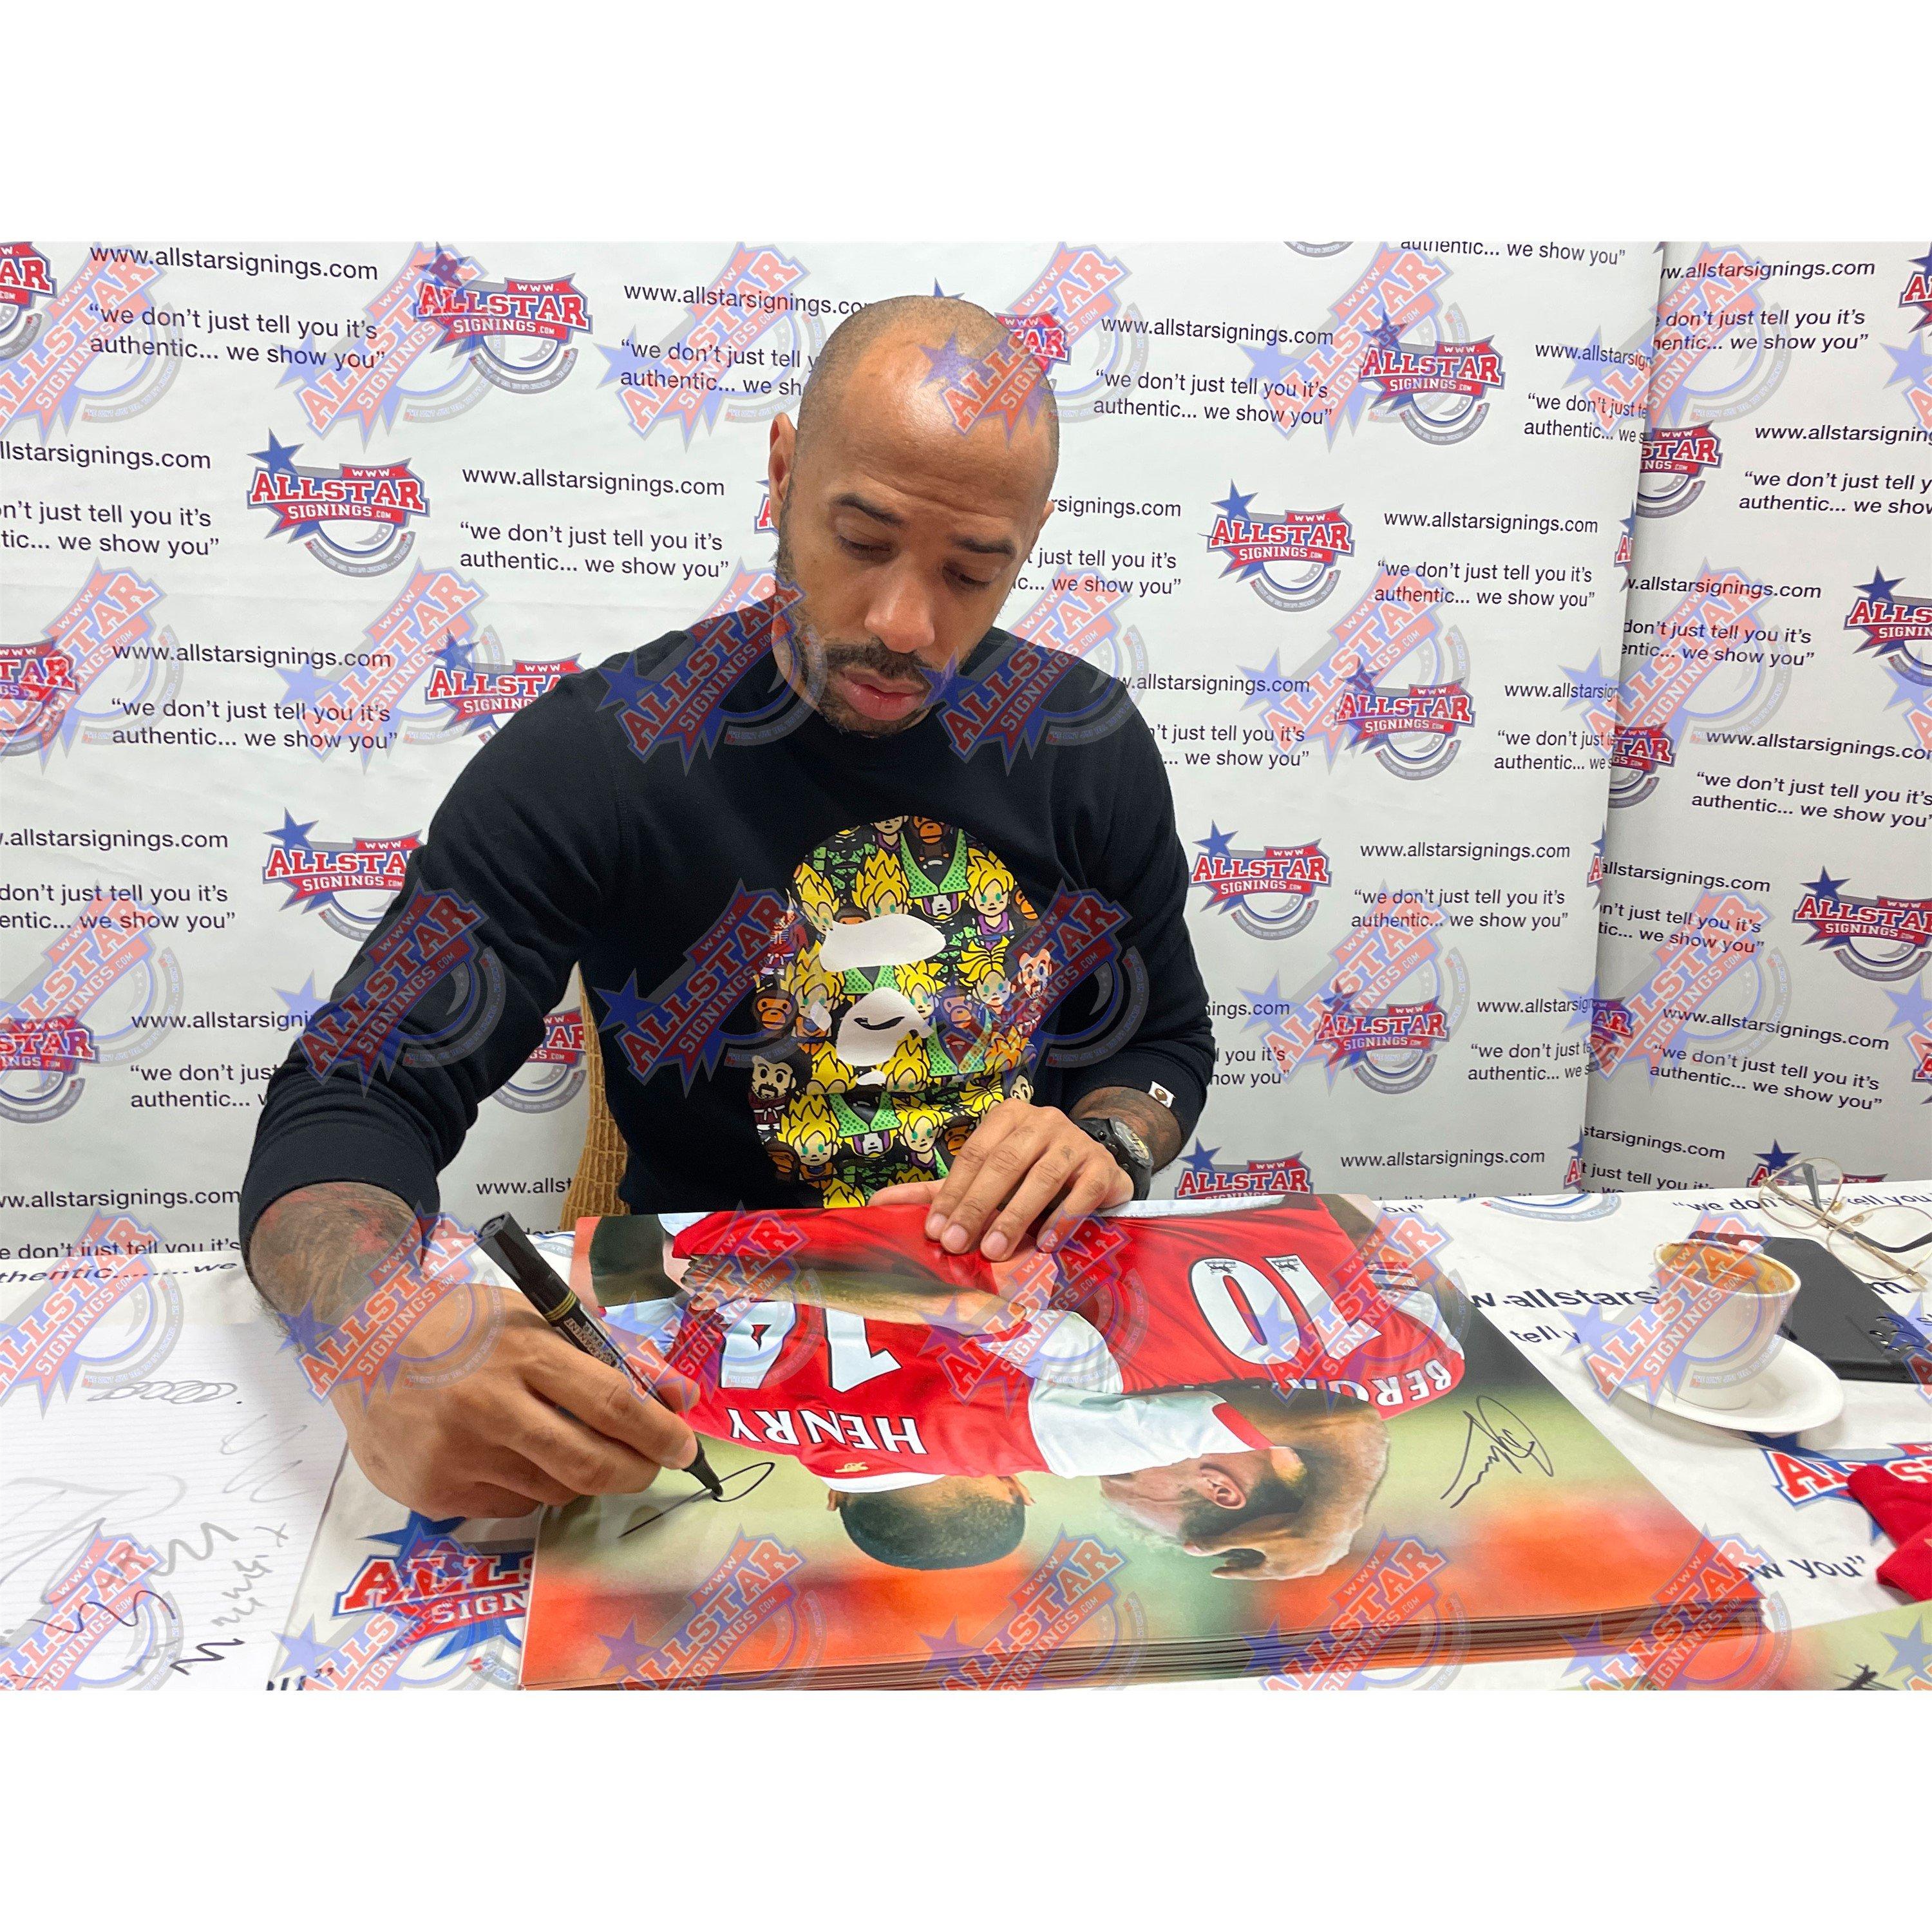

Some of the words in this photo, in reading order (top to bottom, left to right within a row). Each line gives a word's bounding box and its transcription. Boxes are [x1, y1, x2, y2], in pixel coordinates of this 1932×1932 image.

[89, 247, 377, 280] www.allstarsignings.com
[416, 281, 591, 330] ALLSTAR
[1665, 310, 1714, 327] don’t
[1717, 310, 1755, 330] just
[1759, 309, 1790, 325] tell
[1794, 313, 1831, 329] you
[1837, 308, 1865, 325] it’s
[142, 306, 201, 328] don’t
[207, 310, 250, 334] just
[256, 314, 290, 334] tell
[297, 321, 338, 339] you
[346, 319, 377, 339] it’s
[1101, 318, 1333, 346] www.allstarsignings.com
[90, 335, 218, 359] authentic...
[226, 346, 260, 362] we
[267, 345, 327, 366] show
[1730, 337, 1757, 350] we
[1763, 334, 1817, 350] show
[1360, 348, 1504, 386] ALLSTAR
[1137, 372, 1186, 391] don’t
[1189, 374, 1225, 396] just
[1230, 377, 1258, 395] tell
[1263, 383, 1296, 400] you
[1303, 380, 1328, 399] it’s
[1094, 397, 1197, 419] authentic...
[1204, 406, 1230, 420] we
[1236, 404, 1285, 422] show
[250, 471, 426, 513] ALLSTAR
[462, 468, 724, 497] www.allstarsignings.com
[1209, 515, 1353, 551] ALLSTAR
[1384, 511, 1598, 535] www.allstarsignings.com
[508, 524, 562, 543] don’t
[568, 526, 607, 548] just
[612, 529, 643, 547] tell
[650, 534, 687, 552] you
[695, 532, 723, 551] it’s
[460, 550, 577, 571] authentic...
[585, 559, 614, 573] we
[621, 556, 676, 576] show
[1416, 562, 1461, 578] don’t
[1463, 562, 1498, 583] just
[1503, 564, 1530, 580] tell
[1535, 569, 1566, 585] you
[1571, 566, 1592, 583] it’s
[1374, 585, 1470, 604] authentic...
[1477, 592, 1502, 605] we
[1508, 589, 1555, 606] show
[111, 643, 391, 670] www.allstarsignings.com
[162, 699, 220, 718] don’t
[226, 700, 267, 723] just
[273, 702, 306, 720] tell
[313, 707, 353, 724] you
[361, 704, 390, 722] it’s
[112, 726, 236, 746] authentic...
[244, 733, 276, 746] we
[283, 730, 342, 748] show
[1171, 724, 1206, 744] just
[1210, 724, 1237, 741] tell
[1242, 729, 1274, 745] you
[1280, 726, 1305, 742] it’s
[1184, 753, 1211, 765] we
[1216, 750, 1264, 766] show
[1736, 775, 1785, 792] don’t
[1788, 779, 1825, 797] just
[1830, 783, 1859, 799] tell
[1863, 789, 1900, 803] you
[1691, 795, 1793, 815] authentic...
[1800, 805, 1828, 817] we
[1833, 806, 1886, 823] show
[1360, 842, 1570, 862] www.allstarsignings.com
[1192, 856, 1331, 884] ALLSTAR
[1392, 889, 1434, 904] don’t
[1437, 888, 1470, 907] just
[1475, 889, 1501, 904] tell
[1506, 893, 1538, 908] you
[1543, 889, 1565, 904] it’s
[1351, 912, 1443, 928] authentic...
[1449, 915, 1474, 927] we
[1479, 912, 1527, 927] show
[1316, 1012, 1448, 1041] ALLSTAR
[1663, 1008, 1889, 1051] www.allstarsignings.com
[179, 1064, 234, 1081] don’t
[1650, 1063, 1747, 1089] authentic...
[1752, 1081, 1779, 1094] we
[1783, 1084, 1833, 1103] show
[1692, 1050, 1738, 1068] don’t
[1740, 1056, 1776, 1074] just
[1781, 1063, 1808, 1079] tell
[1812, 1070, 1847, 1085] you
[1853, 1074, 1880, 1090] it’s
[130, 1090, 250, 1108] authentic...
[1340, 1149, 1545, 1168] www.allstarsignings.com
[1177, 1168, 1311, 1197] ALLSTAR
[1188, 1253, 1383, 1365] 10
[1510, 1325, 1562, 1343] tell
[726, 1407, 929, 1455] HENRY
